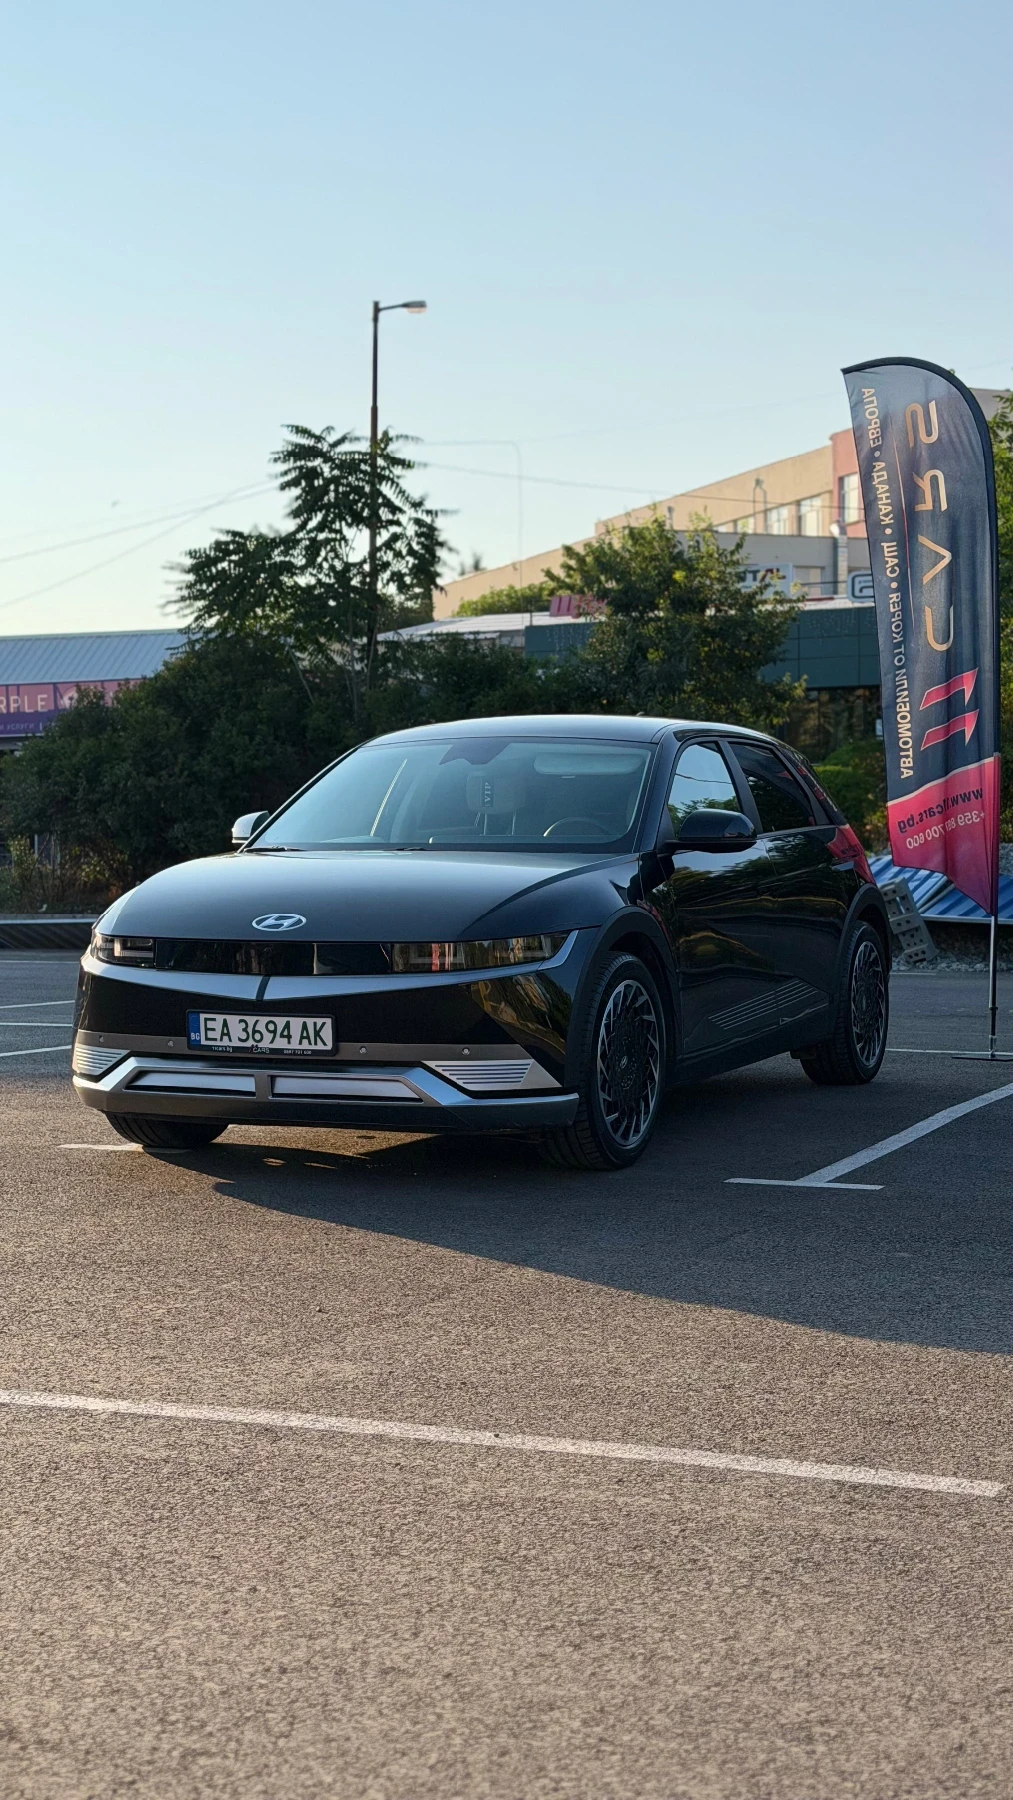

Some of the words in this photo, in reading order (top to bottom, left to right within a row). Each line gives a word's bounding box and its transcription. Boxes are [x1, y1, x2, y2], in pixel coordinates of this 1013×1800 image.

[190, 1032, 200, 1041] BG
[204, 1017, 232, 1043] EA
[237, 1018, 293, 1046] 3694
[298, 1020, 328, 1047] AK
